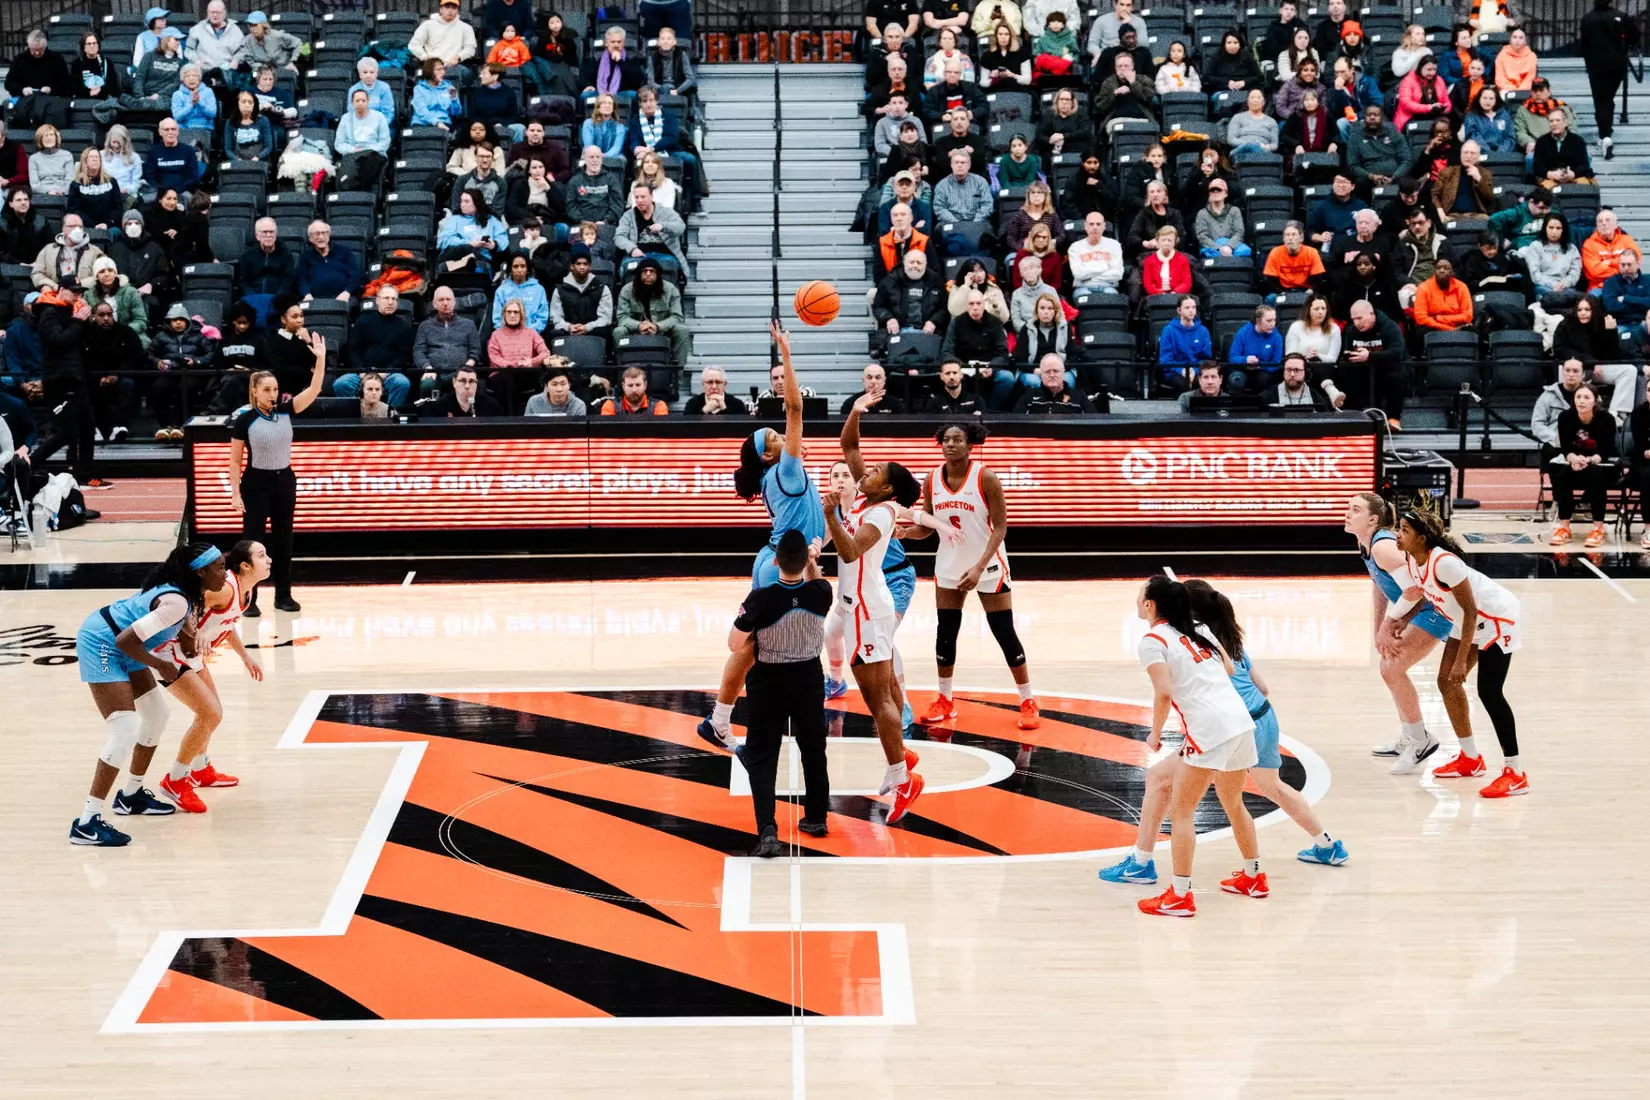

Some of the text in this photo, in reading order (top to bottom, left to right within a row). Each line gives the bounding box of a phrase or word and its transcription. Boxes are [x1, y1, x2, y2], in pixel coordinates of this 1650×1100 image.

[1164, 453, 1346, 479] PNC BANK
[296, 465, 736, 496] on't have any secret plays, jus
[934, 500, 975, 513] PRINCETON
[1503, 634, 1512, 647] P
[863, 643, 875, 657] P
